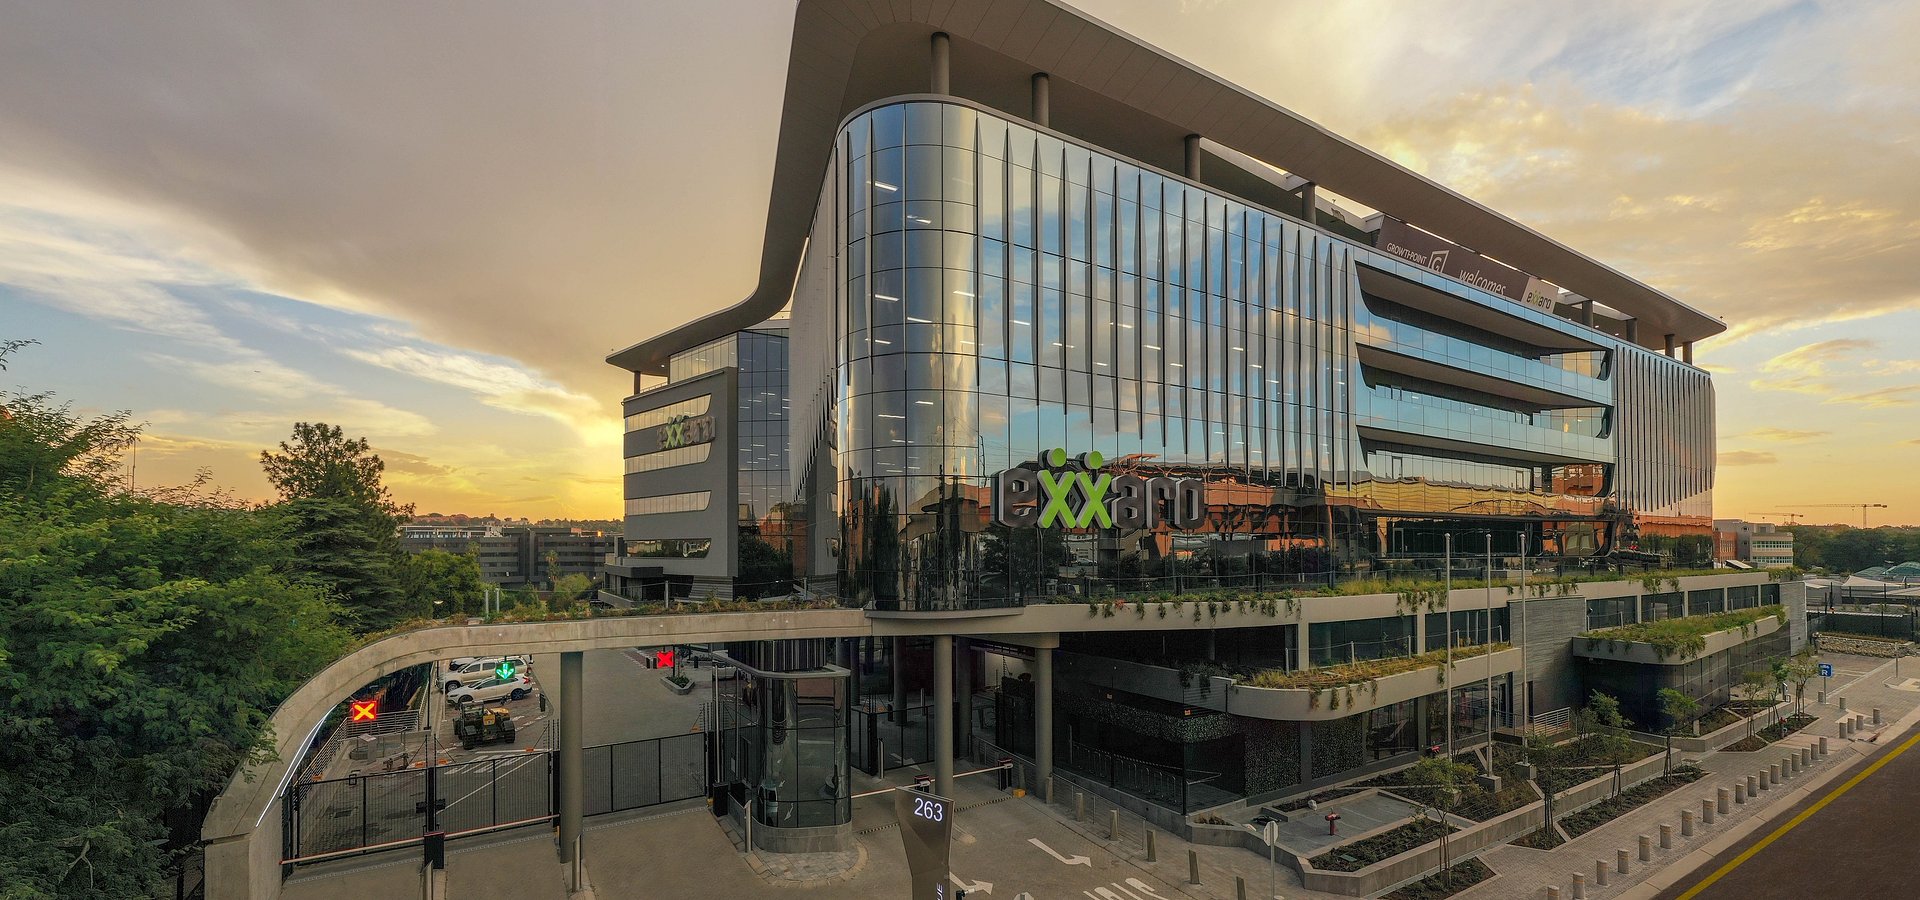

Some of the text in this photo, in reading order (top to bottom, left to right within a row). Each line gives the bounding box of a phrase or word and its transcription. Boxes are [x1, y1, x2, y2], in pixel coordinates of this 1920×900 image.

[1386, 242, 1428, 265] GROWTHPOINT
[1459, 270, 1507, 296] welcomes
[1526, 290, 1552, 310] exxaro
[997, 447, 1205, 530] exxaro
[914, 797, 943, 822] 263
